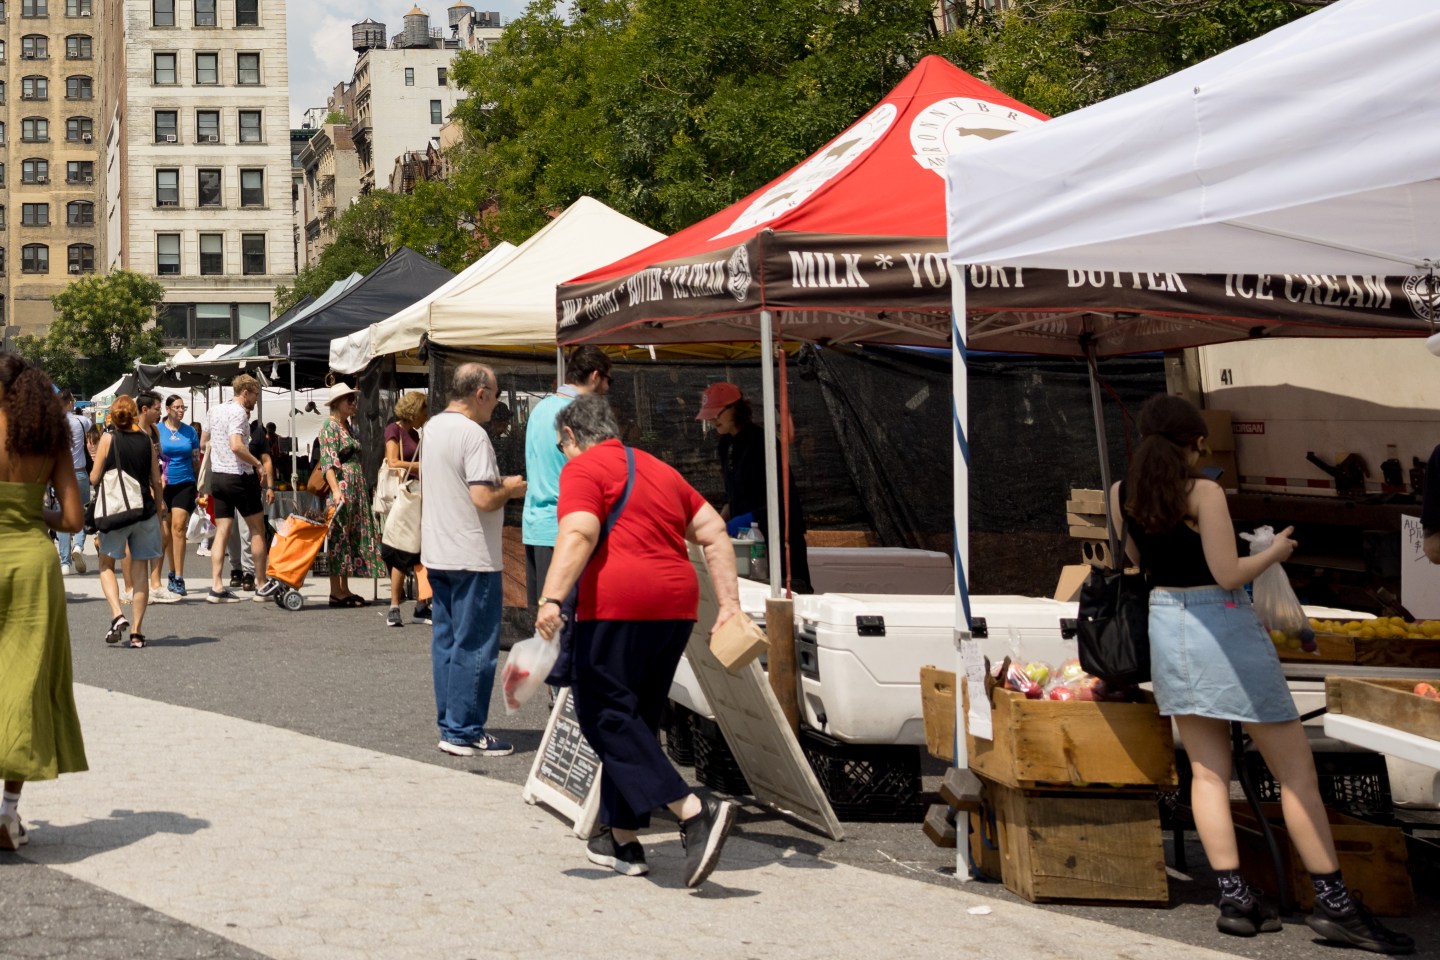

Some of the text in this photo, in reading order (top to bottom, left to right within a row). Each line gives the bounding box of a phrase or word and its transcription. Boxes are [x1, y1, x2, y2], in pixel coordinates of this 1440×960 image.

[627, 267, 664, 308] BUTTER
[670, 265, 690, 300] ICE
[690, 259, 728, 299] CREAM
[788, 250, 870, 288] MILK
[901, 252, 1025, 289] YOURT
[1224, 274, 1274, 301] ICE
[1283, 275, 1392, 309] CREAM
[1221, 368, 1233, 385] 41
[1232, 423, 1264, 433] ORGAN
